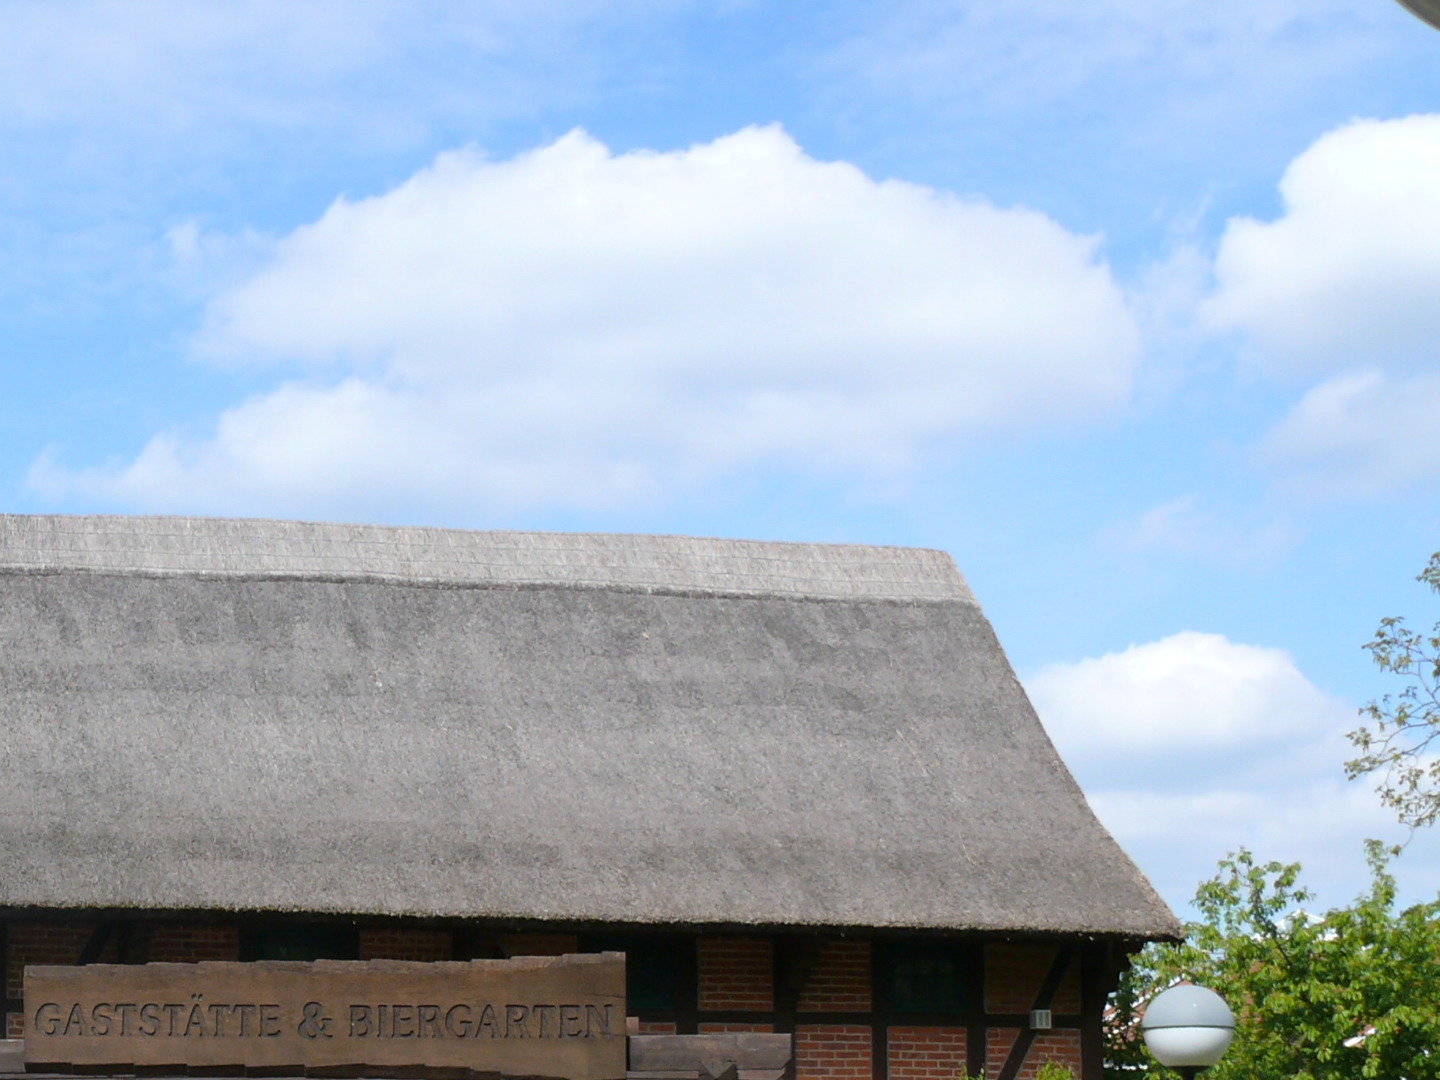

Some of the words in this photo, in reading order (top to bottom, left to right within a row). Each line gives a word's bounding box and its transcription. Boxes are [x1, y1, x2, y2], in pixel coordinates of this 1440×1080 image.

[34, 993, 282, 1038] GASTSTÄTTE
[297, 1001, 333, 1039] &
[348, 1003, 613, 1040] BIERGARTEN
